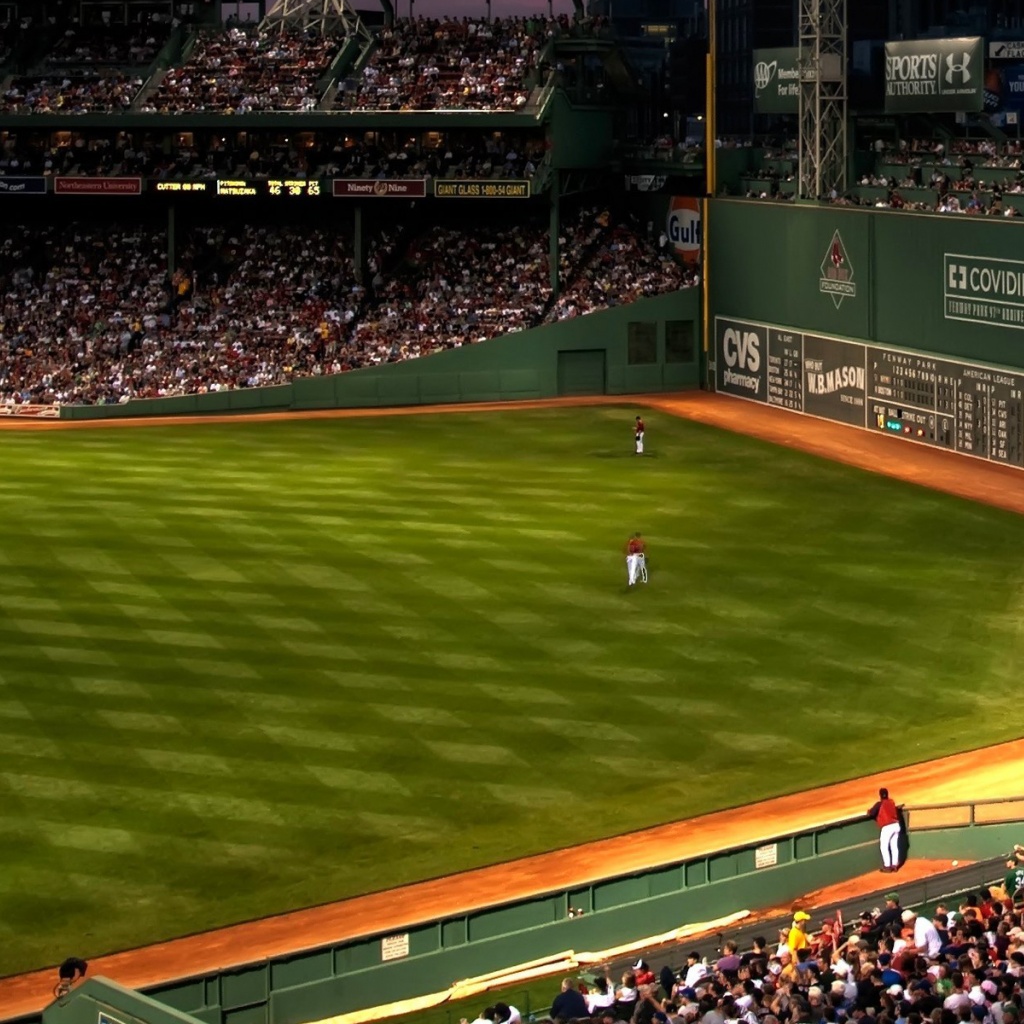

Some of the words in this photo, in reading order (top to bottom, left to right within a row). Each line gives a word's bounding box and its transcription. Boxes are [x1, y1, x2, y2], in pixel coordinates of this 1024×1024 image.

[885, 54, 937, 80] SPORTS
[778, 84, 787, 95] For
[886, 80, 937, 95] AUTHORITY
[60, 181, 101, 189] Northeastern
[103, 181, 137, 191] University
[347, 183, 373, 193] Ninety
[388, 184, 407, 192] Nine
[438, 184, 457, 195] GIANT
[458, 184, 479, 195] GLASS
[506, 185, 526, 195] GIANT
[948, 300, 972, 315] FENWAY
[972, 303, 988, 317] PARK
[723, 328, 760, 373] CVS
[883, 353, 912, 366] FENWAY
[917, 359, 936, 370] PARK
[723, 368, 760, 394] pharmacy
[963, 369, 991, 381] AMERICAN
[993, 375, 1015, 386] LEAGUE
